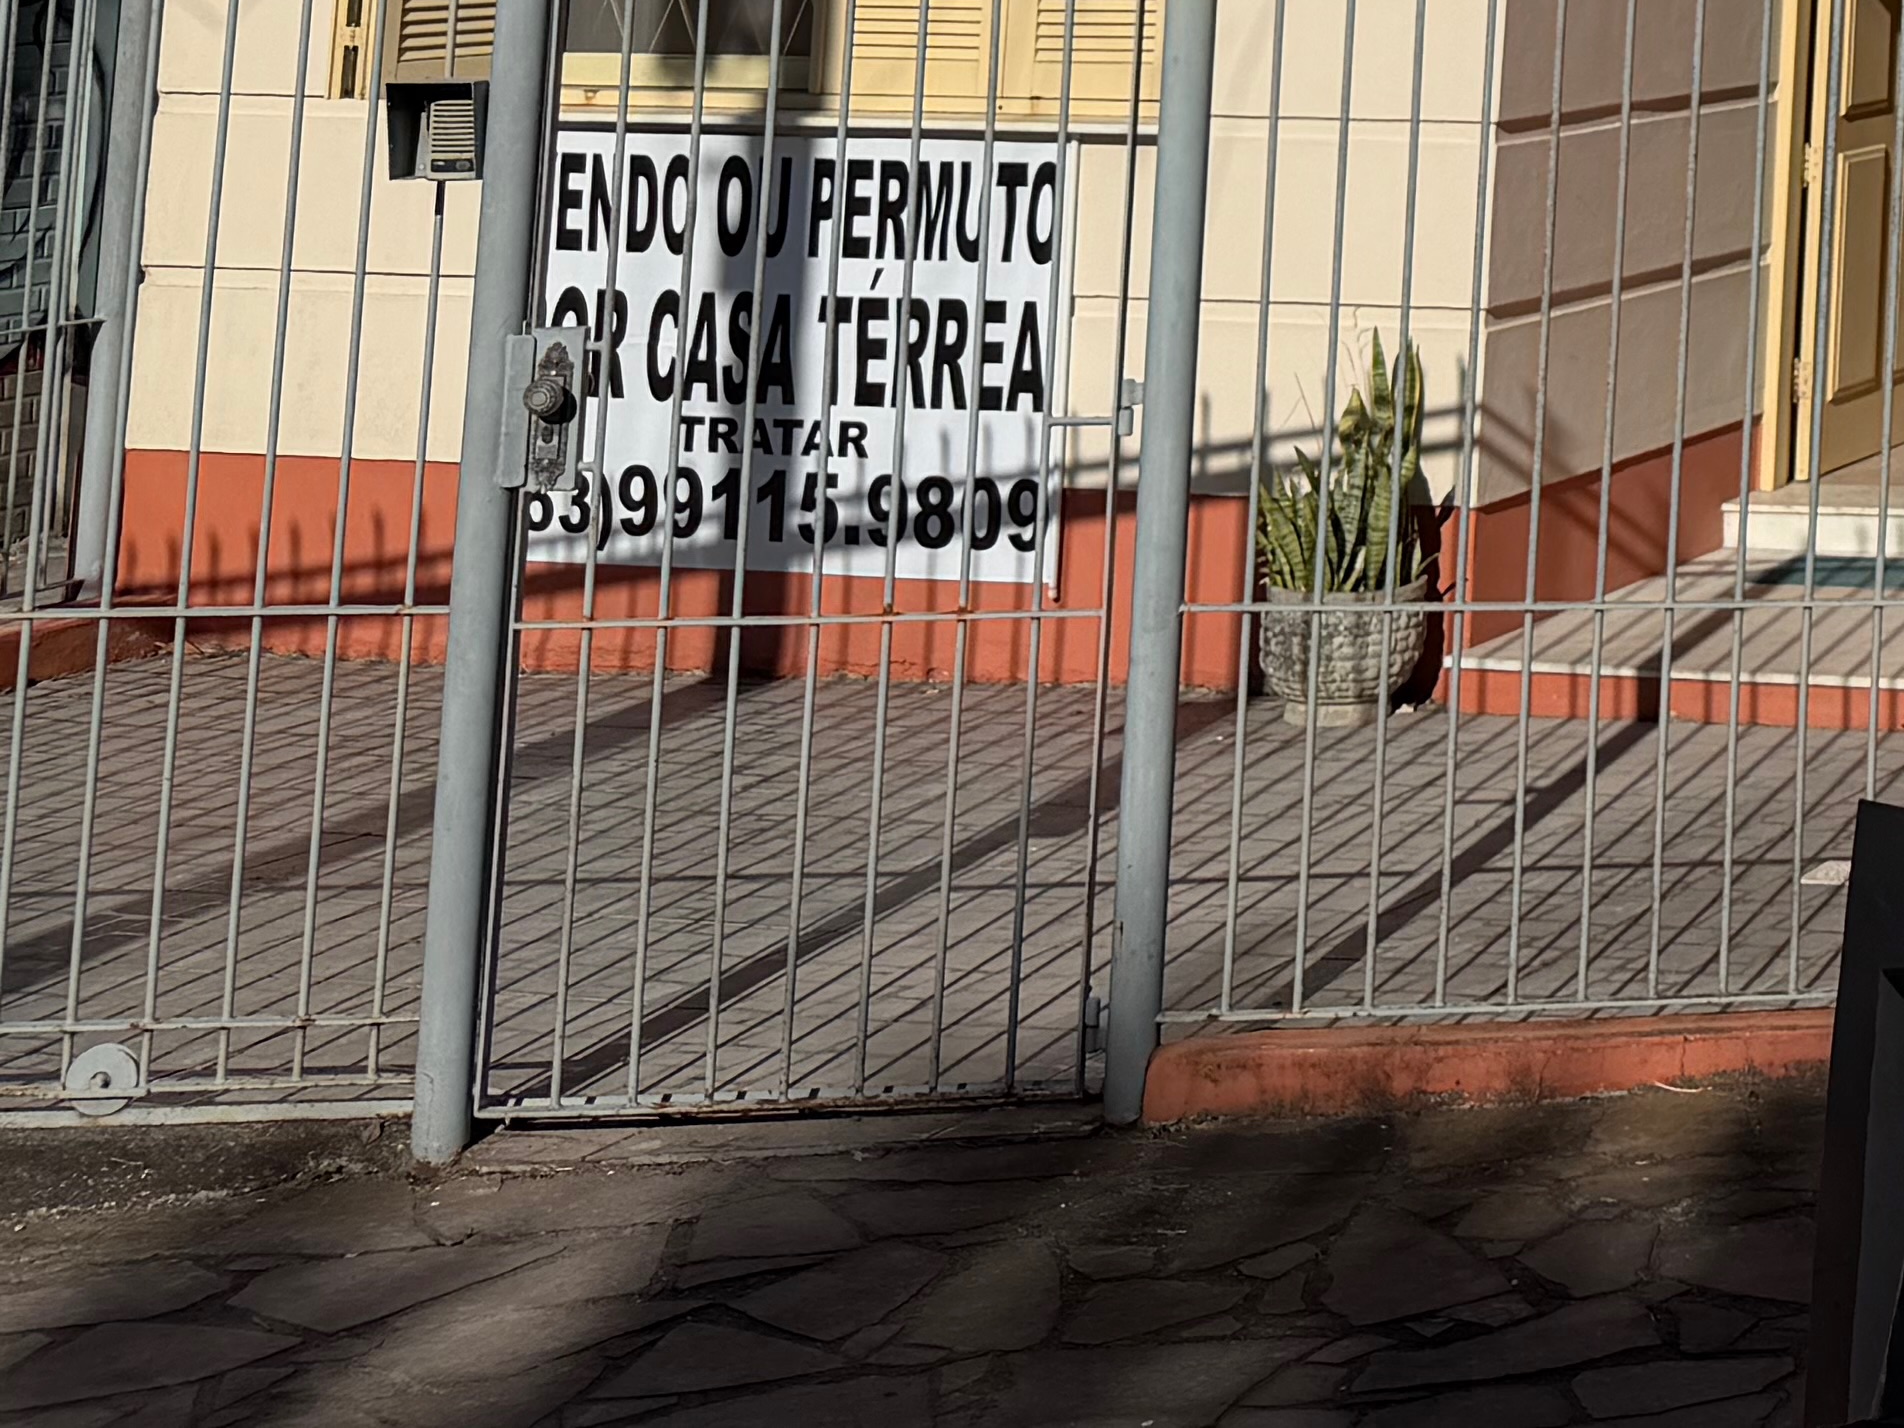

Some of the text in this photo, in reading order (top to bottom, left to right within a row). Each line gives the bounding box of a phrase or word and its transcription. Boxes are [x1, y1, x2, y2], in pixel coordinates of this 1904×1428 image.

[555, 152, 1058, 264] ENDO OU PERMUTO
[646, 287, 796, 406] CASA
[819, 268, 1044, 412] TÉRREA
[680, 414, 869, 459] TRATAR
